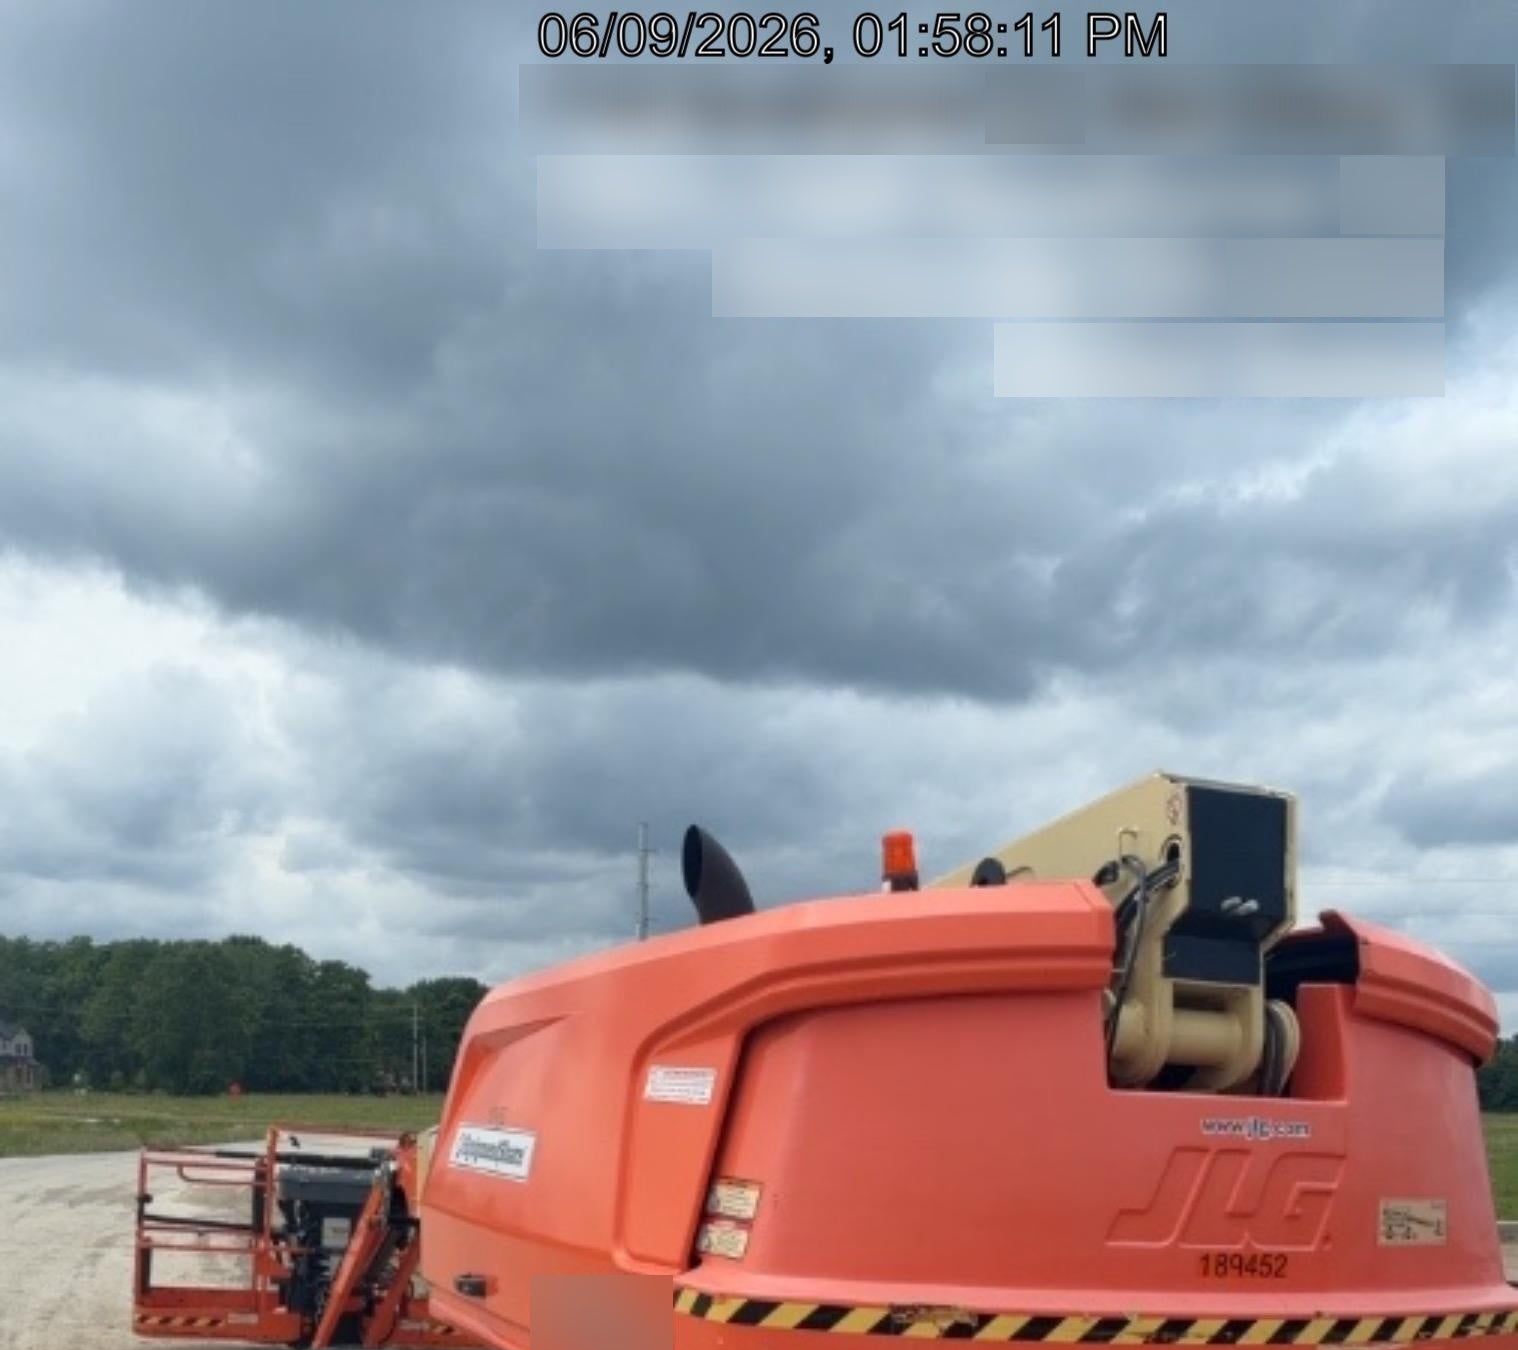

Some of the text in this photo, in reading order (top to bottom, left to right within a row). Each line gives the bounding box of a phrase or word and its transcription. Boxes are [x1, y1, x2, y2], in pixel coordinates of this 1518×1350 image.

[1202, 1118, 1310, 1139] www.jlg.com
[1104, 1146, 1347, 1251] JLG
[1200, 1254, 1288, 1278] 189452
